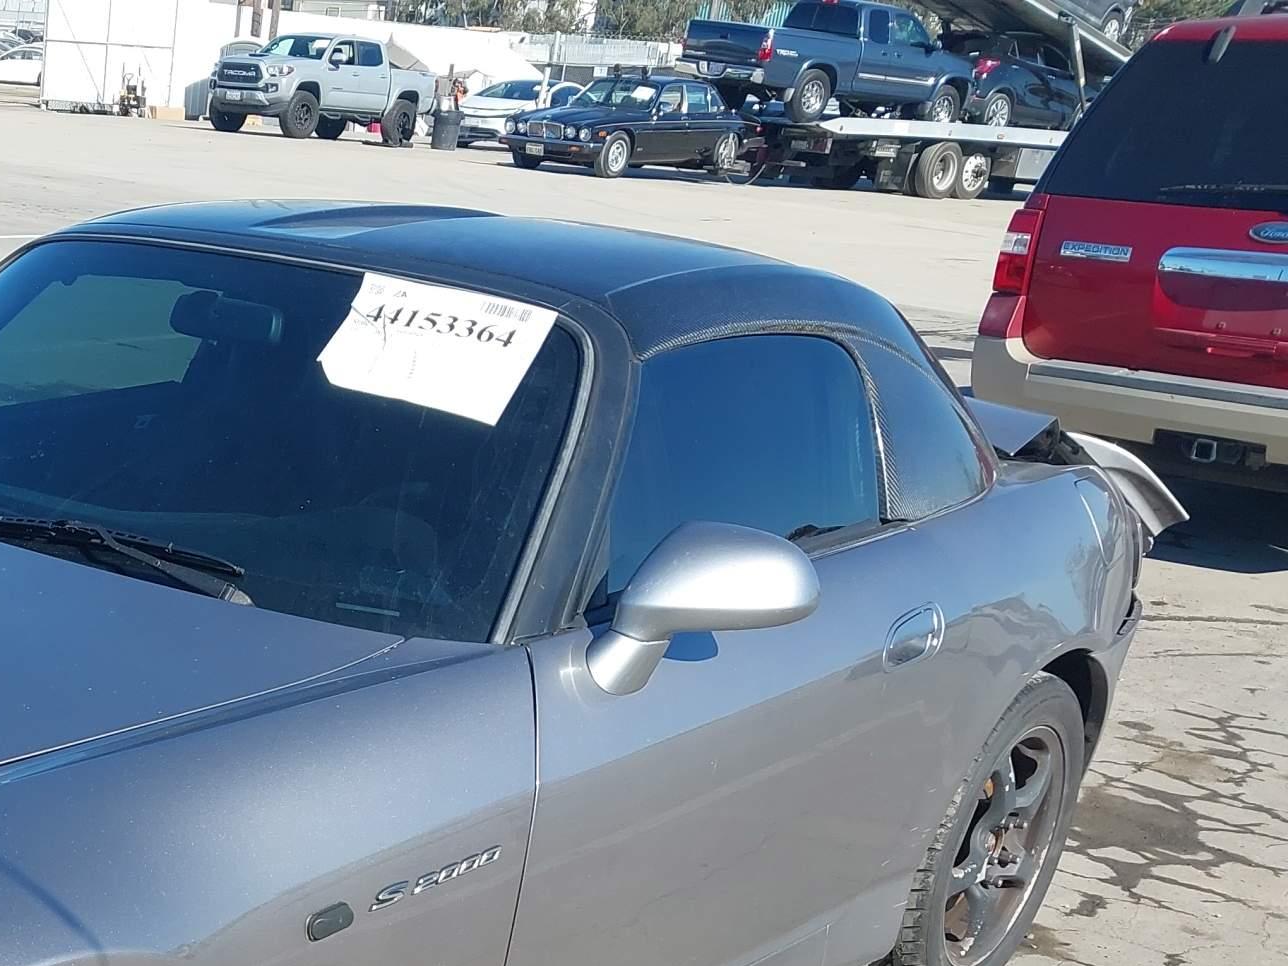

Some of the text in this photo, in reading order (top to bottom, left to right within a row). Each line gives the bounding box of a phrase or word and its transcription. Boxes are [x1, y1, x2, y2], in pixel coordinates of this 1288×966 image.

[224, 69, 256, 77] TACOMA
[1063, 242, 1129, 257] EXPEDITION
[366, 303, 517, 348] 44153364
